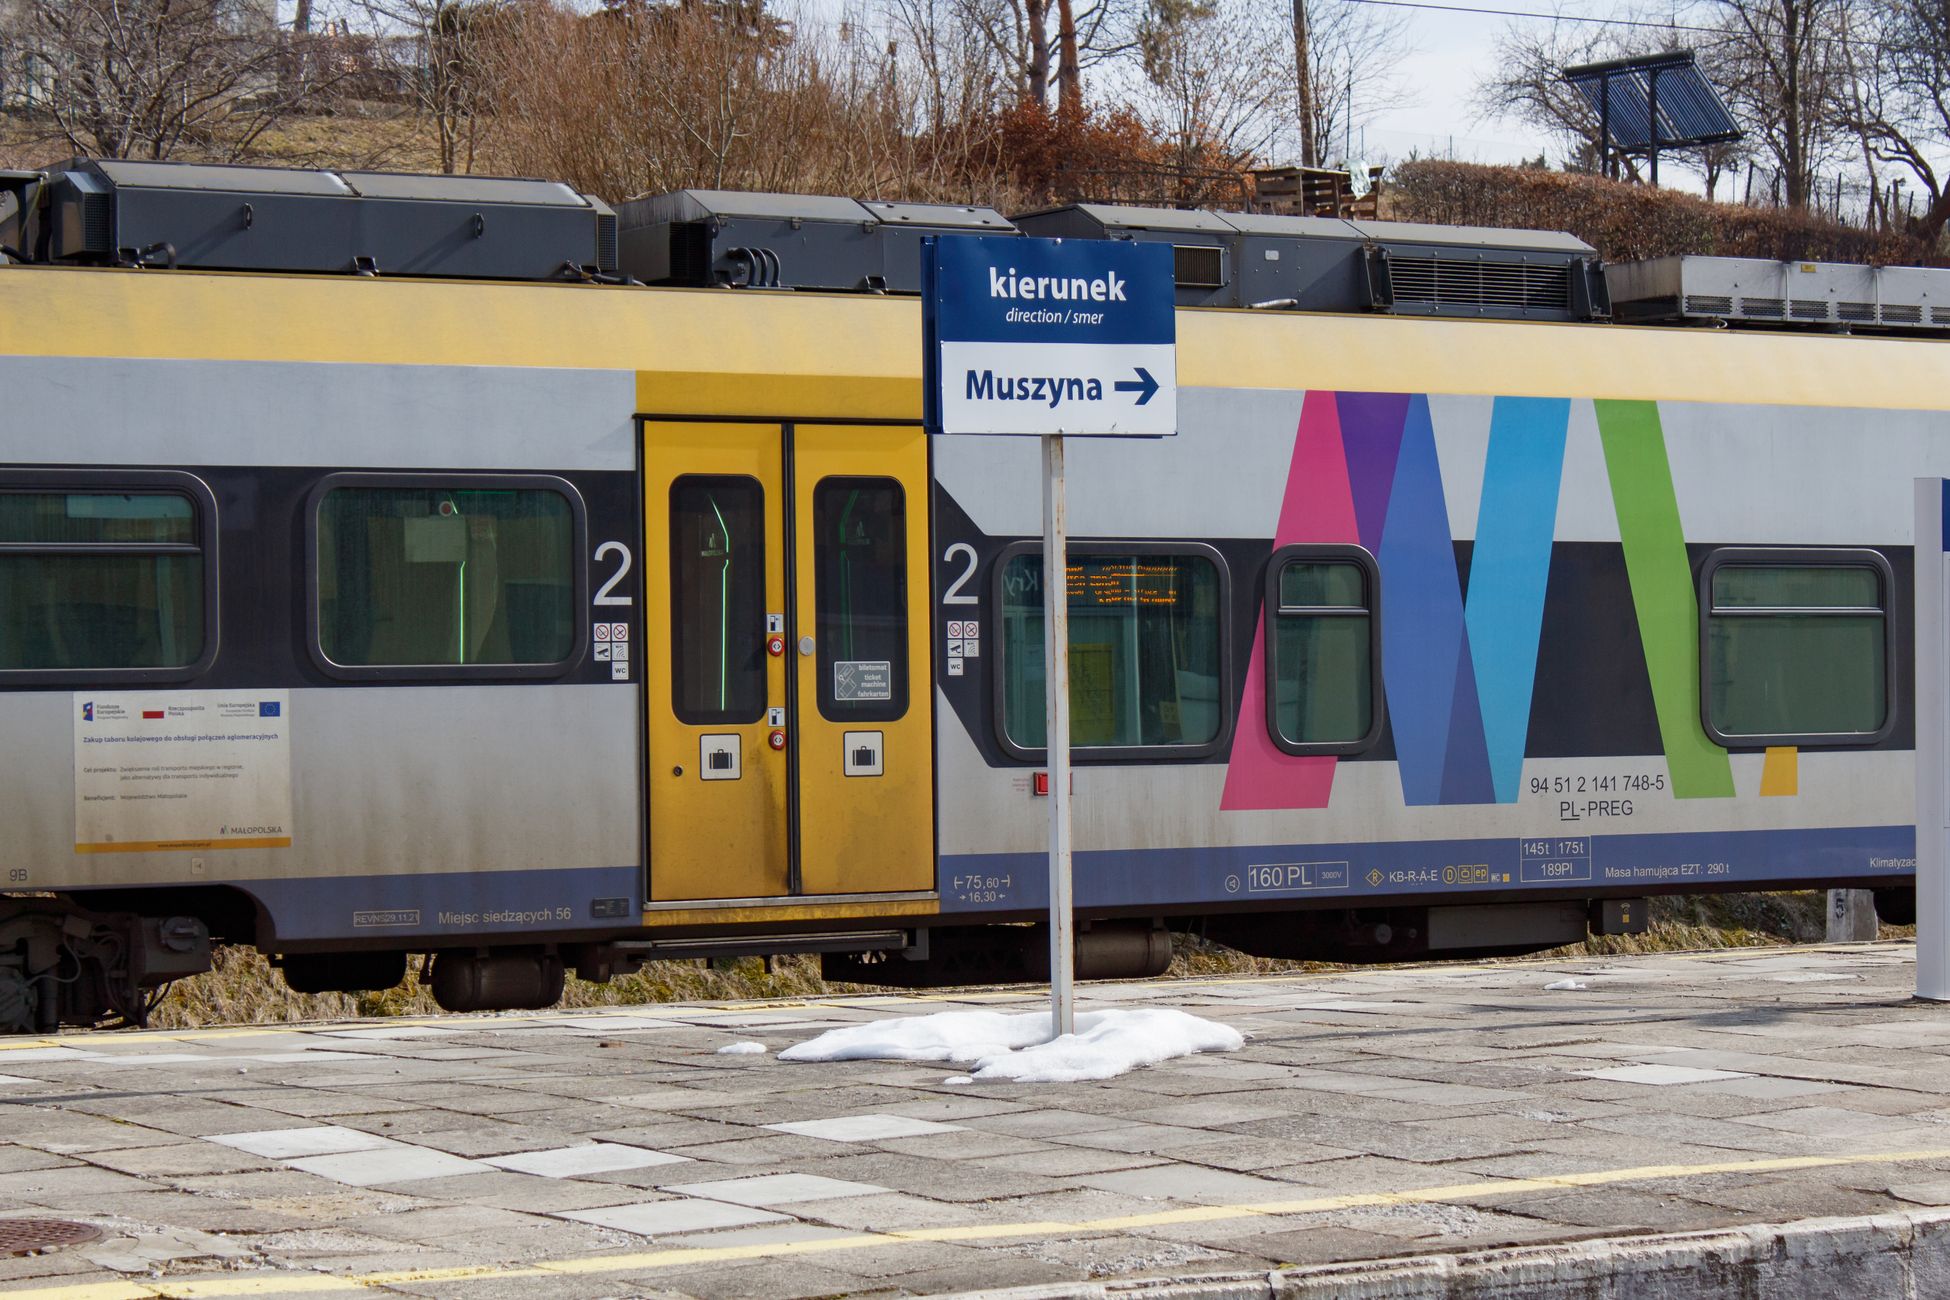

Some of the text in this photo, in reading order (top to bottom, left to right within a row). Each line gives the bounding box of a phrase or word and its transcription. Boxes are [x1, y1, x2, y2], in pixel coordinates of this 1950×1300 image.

[989, 266, 1127, 302] kierunek
[1005, 307, 1062, 324] direction
[1072, 312, 1104, 325] smer
[966, 369, 1103, 409] Muszyna
[593, 540, 633, 606] 2
[943, 542, 979, 605] 2
[858, 663, 887, 671] biletomat
[860, 680, 887, 688] machine
[864, 673, 882, 681] ticket
[857, 690, 889, 698] fahrkarten
[83, 736, 103, 744] Zakup
[173, 734, 197, 742] obsługi
[198, 733, 226, 742] połączeń
[227, 732, 279, 741] aglomeracyjnych
[1530, 774, 1664, 794] 94 51 2 141 748-5
[1560, 799, 1634, 821] PL-PREG
[231, 825, 282, 835] MAŁOPOLSKA
[1605, 866, 1631, 878] Masa
[1633, 864, 1679, 879] hamująca
[1681, 864, 1704, 875] EZT:
[1707, 863, 1724, 875] 290
[1869, 856, 1917, 870] Klimatyzac
[9, 868, 28, 882] 9B
[1250, 867, 1283, 887] 160
[1287, 865, 1312, 886] PL
[438, 906, 572, 926] Miejsc siedzących 56
